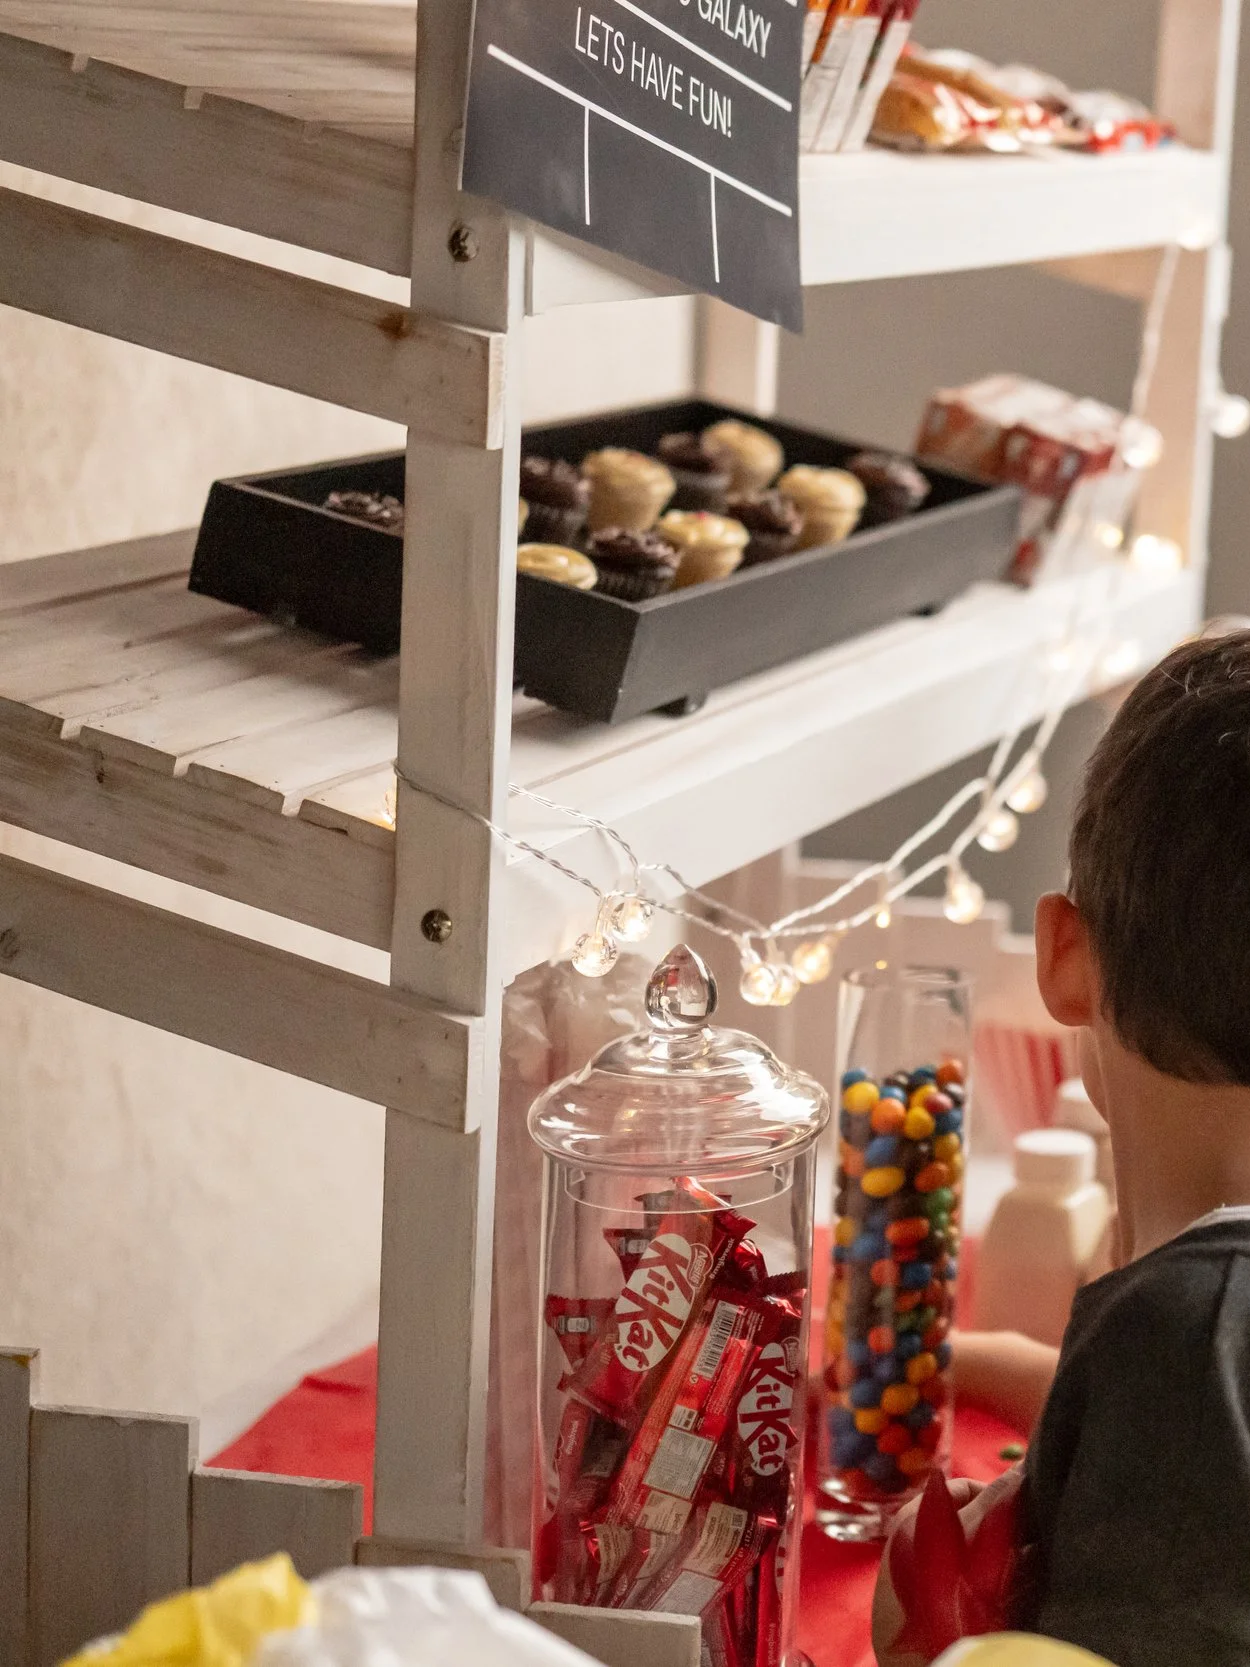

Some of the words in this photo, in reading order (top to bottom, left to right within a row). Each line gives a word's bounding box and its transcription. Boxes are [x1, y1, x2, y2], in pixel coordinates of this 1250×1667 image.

[574, 6, 625, 75] LETS
[631, 41, 684, 110] HAVE
[689, 76, 732, 138] FUN!
[697, 0, 772, 58] GALAXY
